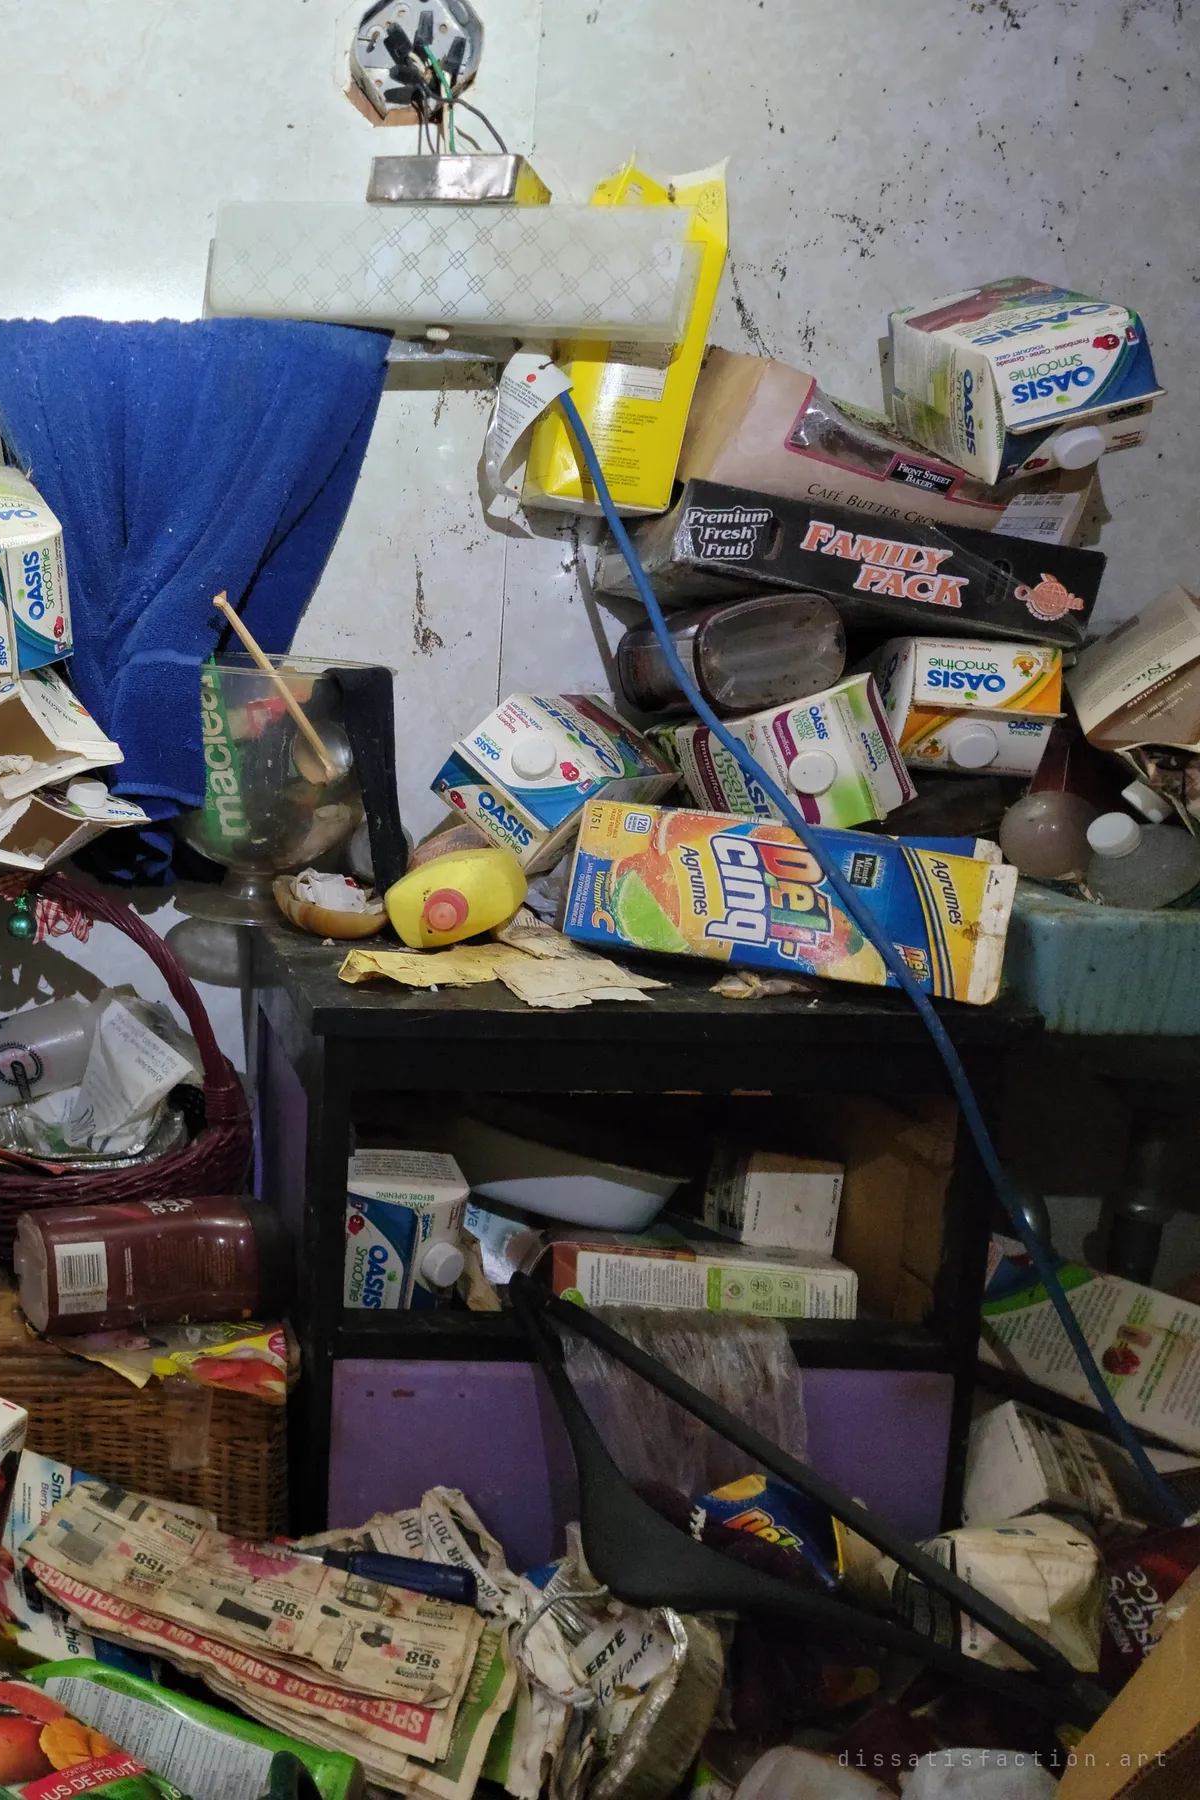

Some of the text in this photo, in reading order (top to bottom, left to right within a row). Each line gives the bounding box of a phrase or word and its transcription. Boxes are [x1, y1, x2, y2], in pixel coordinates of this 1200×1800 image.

[972, 305, 1111, 345] OASIS
[1055, 337, 1090, 350] Framboise
[1012, 366, 1095, 404] OASIS
[962, 369, 977, 456] OASIS
[898, 463, 951, 485] FRONT STREET
[905, 474, 933, 489] BAKERY
[807, 482, 899, 518] CAFÉ BUTTER
[687, 511, 770, 525] Premium
[704, 526, 753, 539] Fresh
[704, 542, 750, 556] Fruit
[801, 521, 953, 574] FAMILY
[24, 551, 40, 620] OASIS
[854, 564, 969, 608] PACK
[927, 670, 1006, 694] OASIS
[1126, 673, 1176, 708] chocolate
[530, 696, 621, 774] OASIS
[775, 720, 792, 756] Immuniforce
[809, 706, 828, 740] OASIS
[1008, 720, 1043, 731] OASIS
[474, 737, 500, 761] OASIS
[700, 740, 726, 809] Immuniforce
[106, 808, 144, 818] OASIS
[478, 791, 534, 846] OASIS
[636, 818, 647, 831] 120
[679, 845, 708, 916] Agrumes
[854, 859, 862, 879] Maid
[864, 857, 874, 884] Minute
[592, 871, 615, 933] Vitamine C
[708, 837, 765, 947] cinq
[929, 857, 962, 926] Agrumes
[376, 1191, 434, 1201] BEFORE OPENING
[362, 1245, 389, 1308] OASIS
[41, 1482, 49, 1512] Berry
[428, 1512, 452, 1545] 2012
[35, 1560, 280, 1685] SAVINGS ON GE APPLIANCES
[272, 1600, 304, 1620] $98
[405, 1651, 440, 1669] $58
[72, 1760, 147, 1790] DE FRUITS
